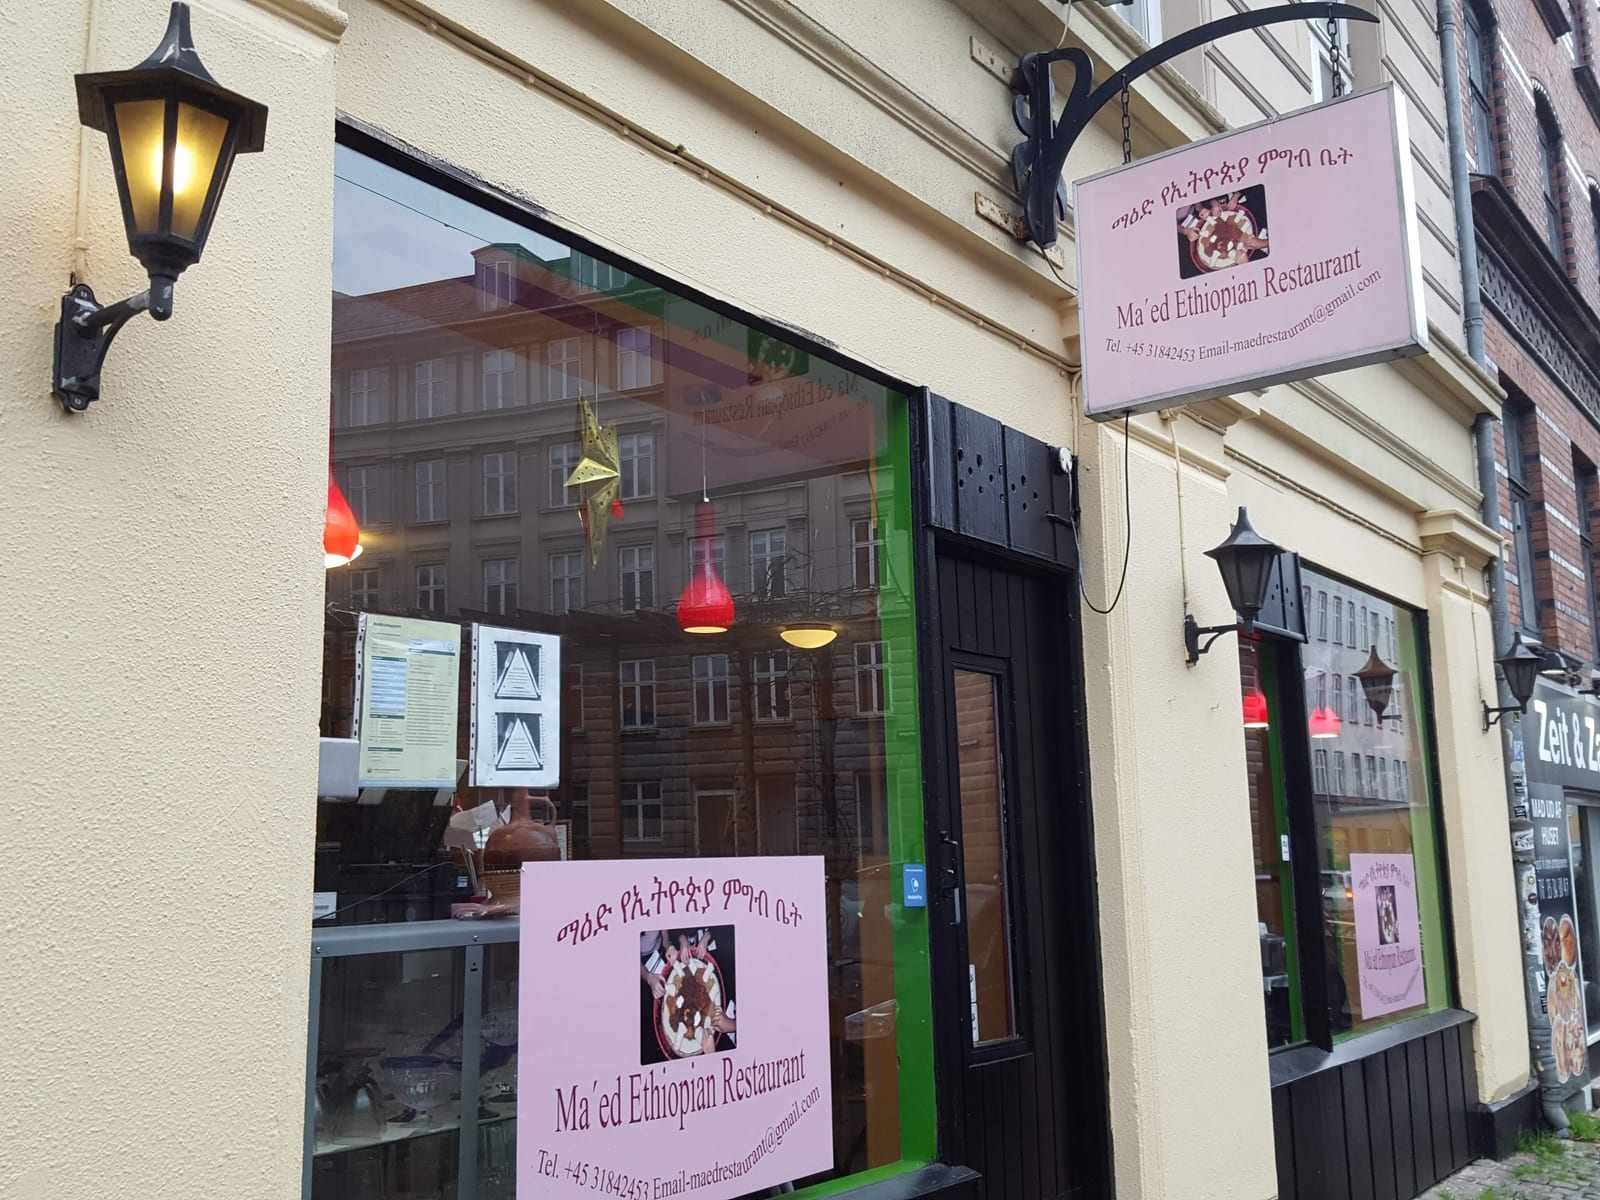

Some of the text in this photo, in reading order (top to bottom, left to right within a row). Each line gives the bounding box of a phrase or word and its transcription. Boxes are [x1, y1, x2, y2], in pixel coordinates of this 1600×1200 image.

[1111, 147, 1353, 230] ማዕድ የኢትዮጵያ ምግብ ቤት
[1105, 269, 1382, 362] Tel. +45 31842453 Email-maedrestaurant@gmail.com
[1175, 275, 1258, 318] Ethiopian
[1264, 246, 1362, 298] Restaurant
[1533, 699, 1572, 766] Zeit
[1572, 712, 1586, 768] &
[557, 876, 802, 945] ማዕድ የኢትዮጵያ ምግብ ቤት
[629, 1061, 717, 1130] Ethiopian
[722, 1048, 806, 1105] Restaurant
[537, 1086, 821, 1200] Tel. +45 31842453 Email-maedrestaurant@gmail.com
